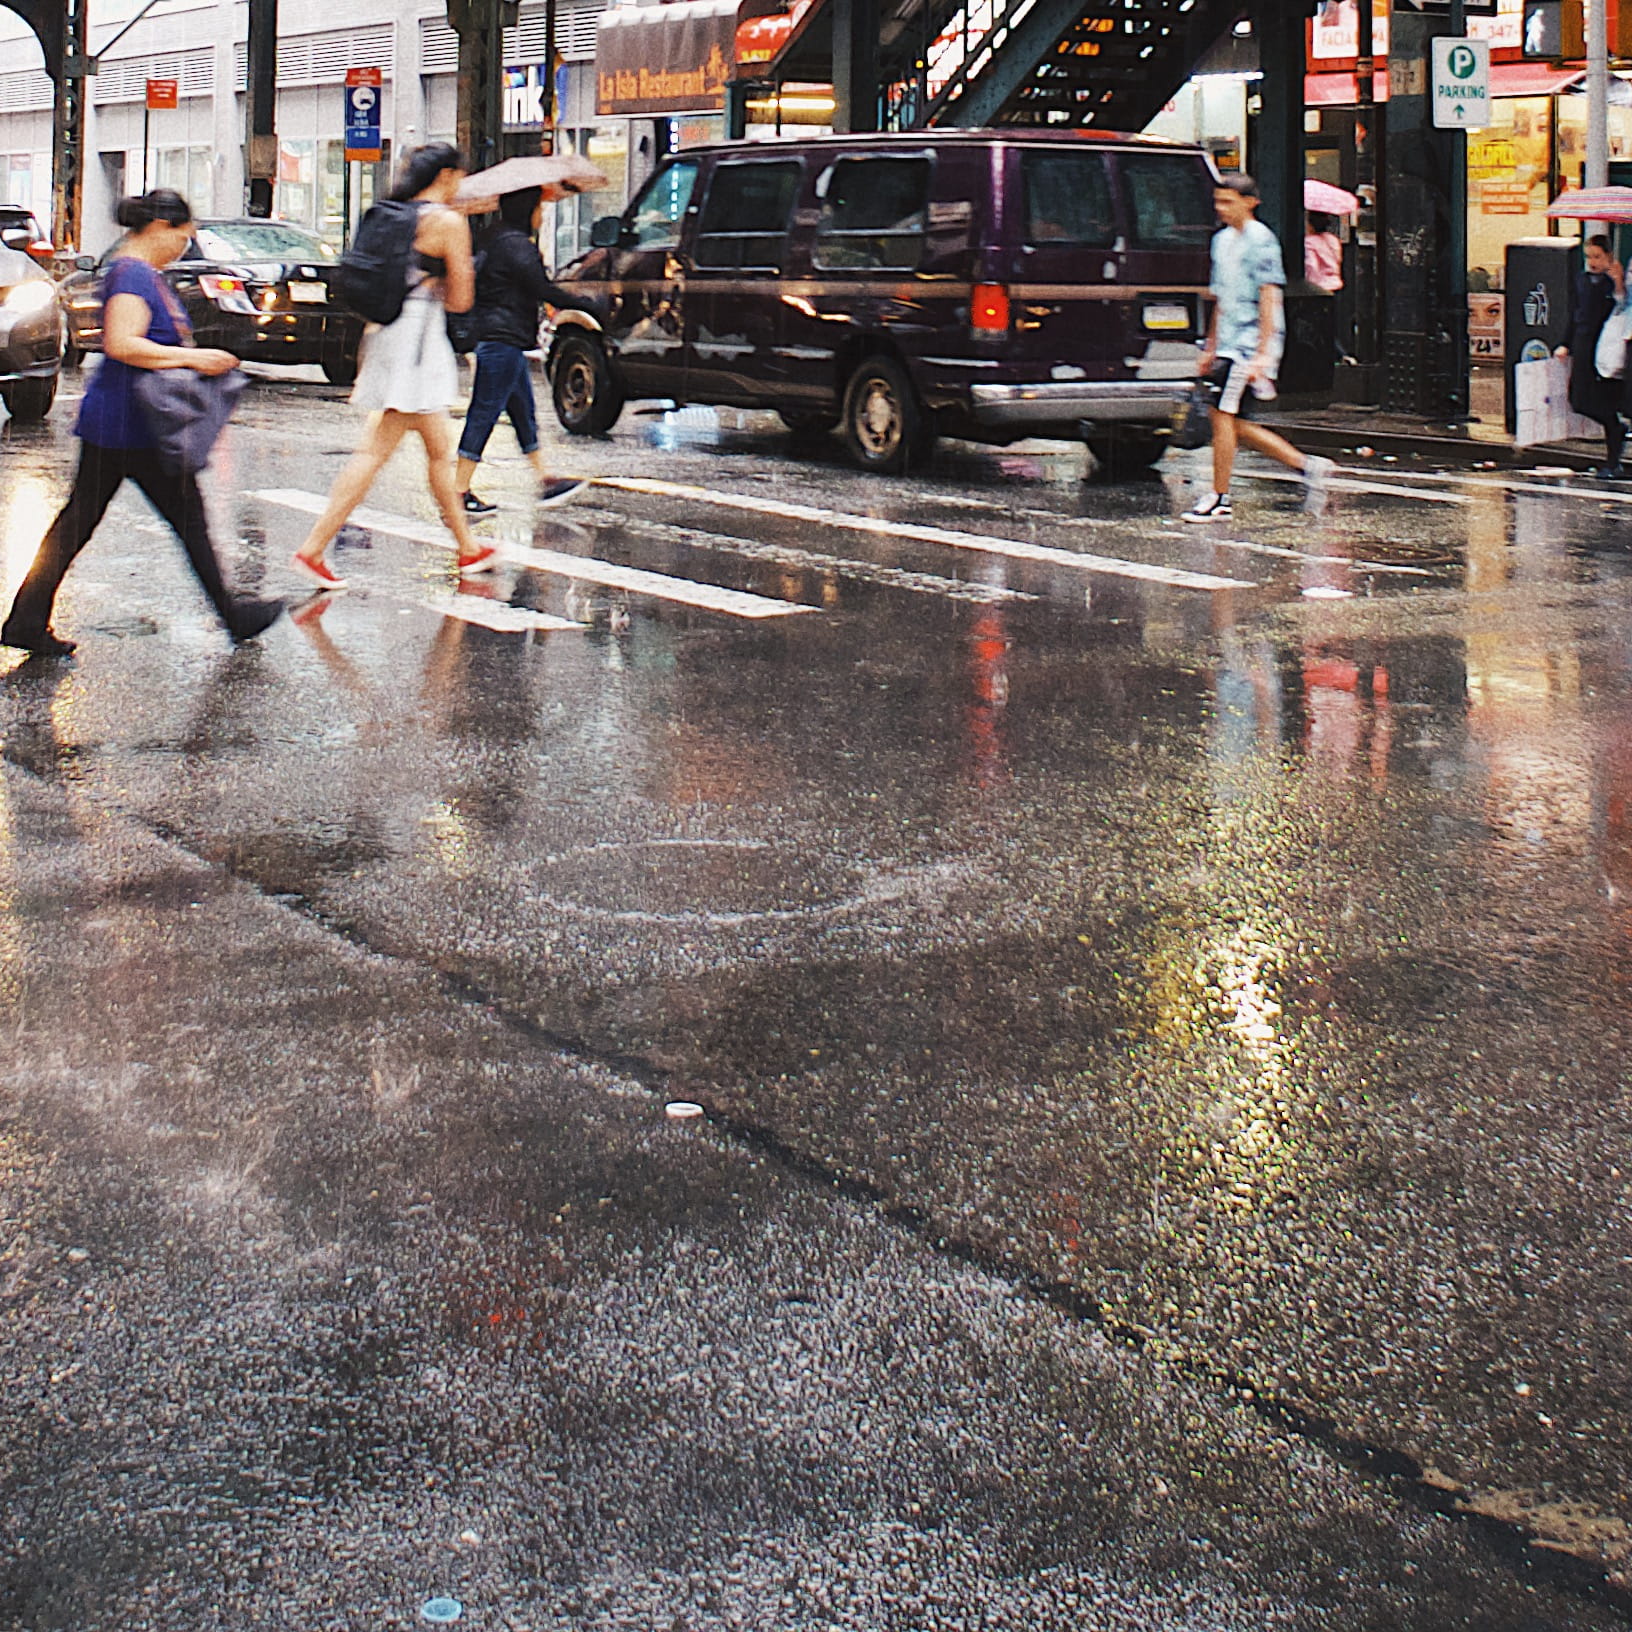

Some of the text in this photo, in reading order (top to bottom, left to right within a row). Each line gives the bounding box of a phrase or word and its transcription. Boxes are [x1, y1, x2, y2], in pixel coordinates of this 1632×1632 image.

[599, 71, 614, 102] La
[639, 65, 706, 99] Restaurant
[1438, 84, 1486, 100] PARKING
